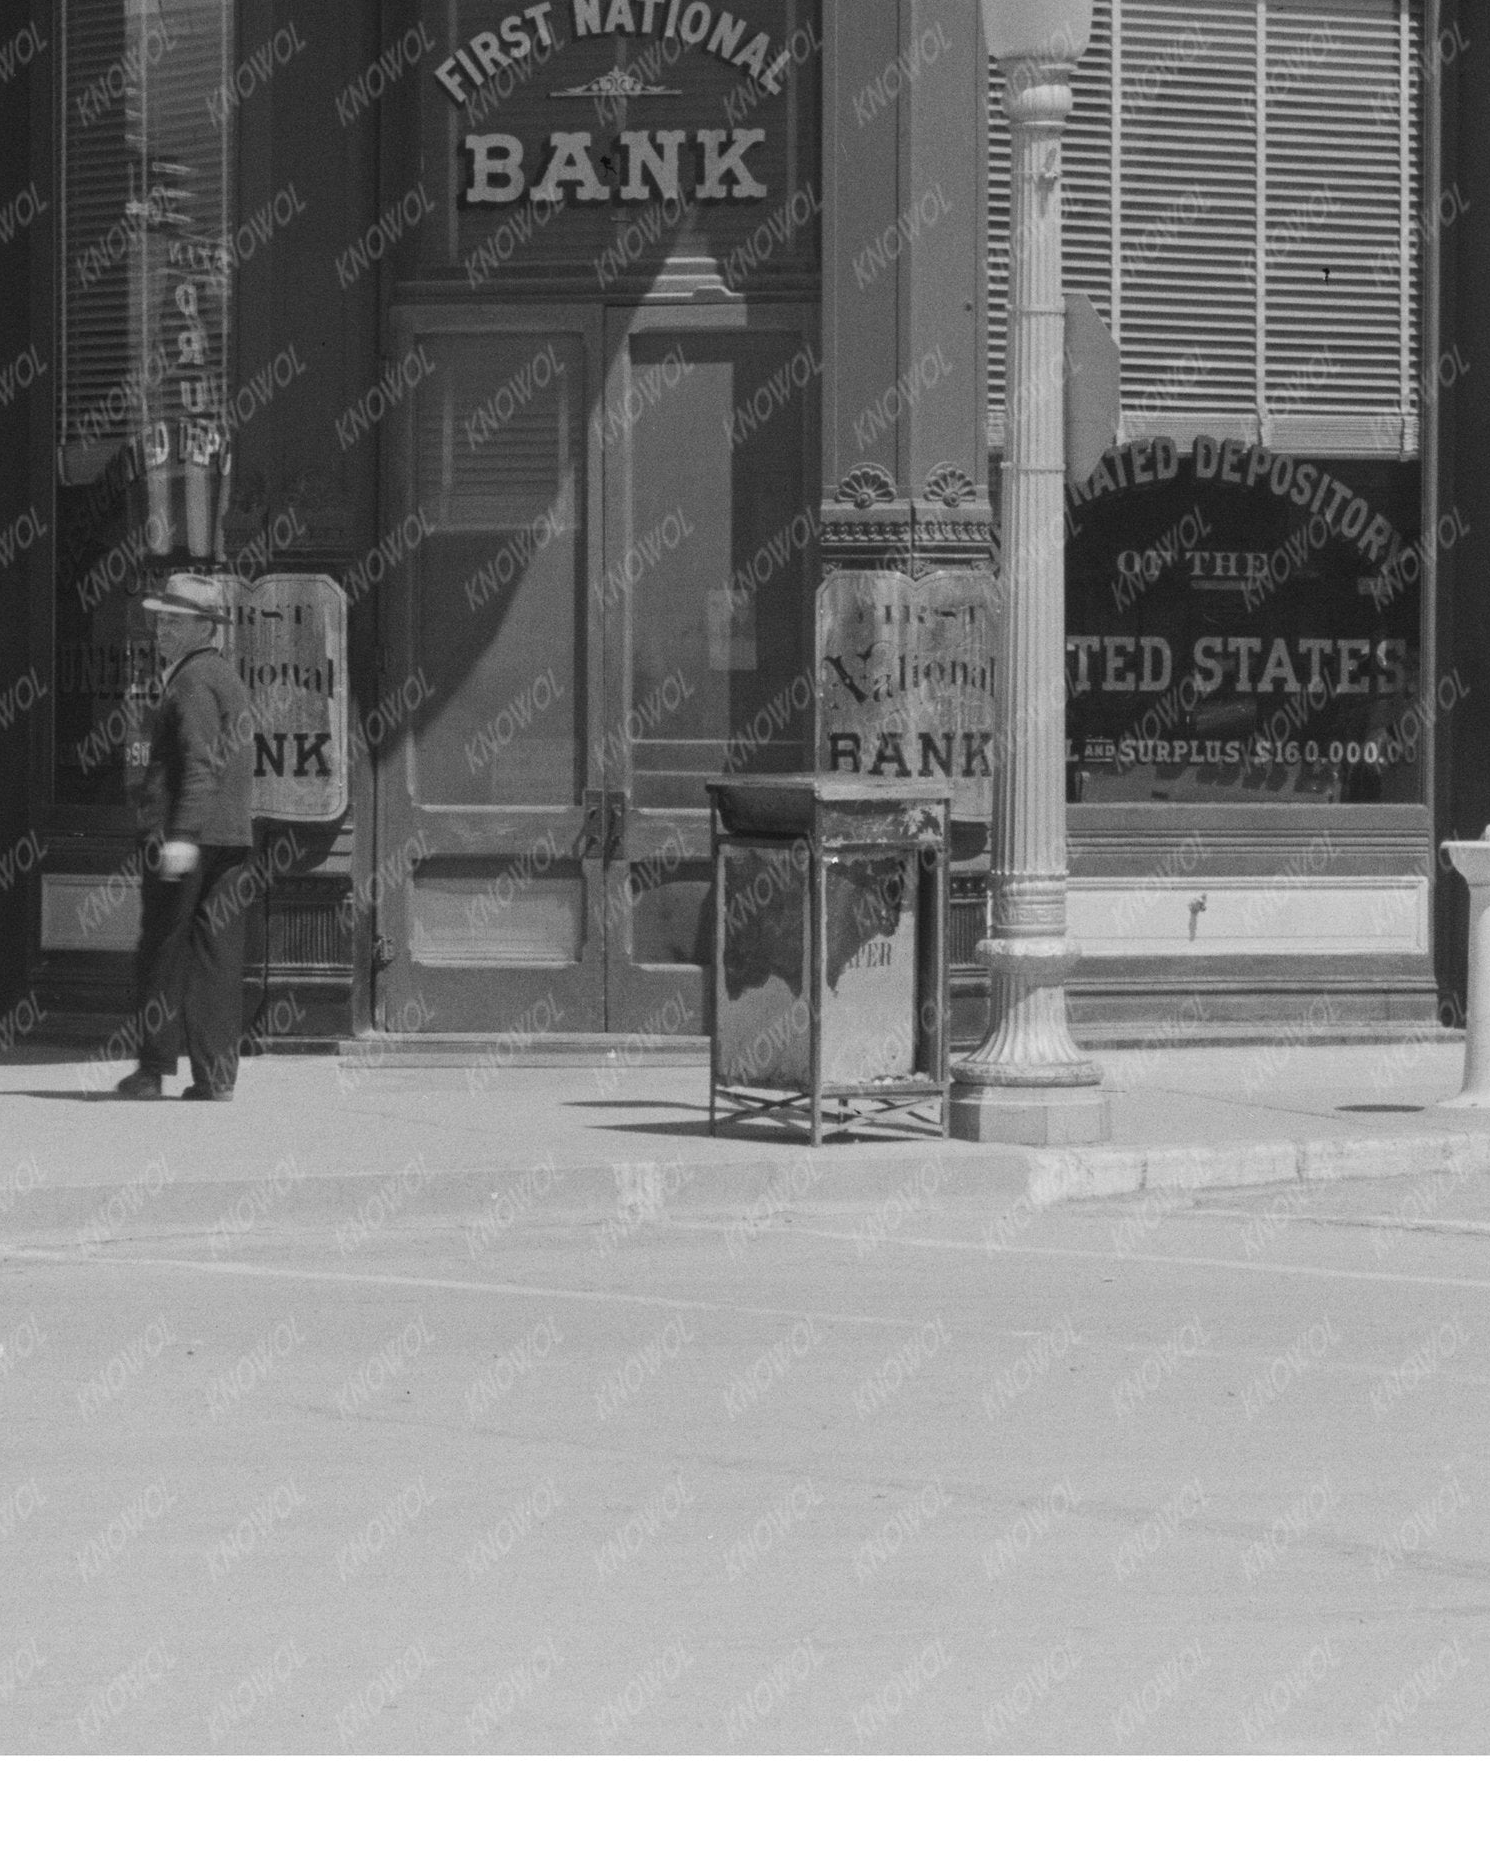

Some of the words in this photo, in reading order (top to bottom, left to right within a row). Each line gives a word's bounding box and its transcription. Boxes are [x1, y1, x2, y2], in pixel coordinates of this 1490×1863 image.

[435, 1, 552, 103] FIRST
[464, 127, 767, 203] BANK
[1185, 550, 1269, 576] THE
[253, 733, 332, 778] NK
[828, 732, 994, 778] BANK
[1119, 738, 1241, 764] SURPLUS
